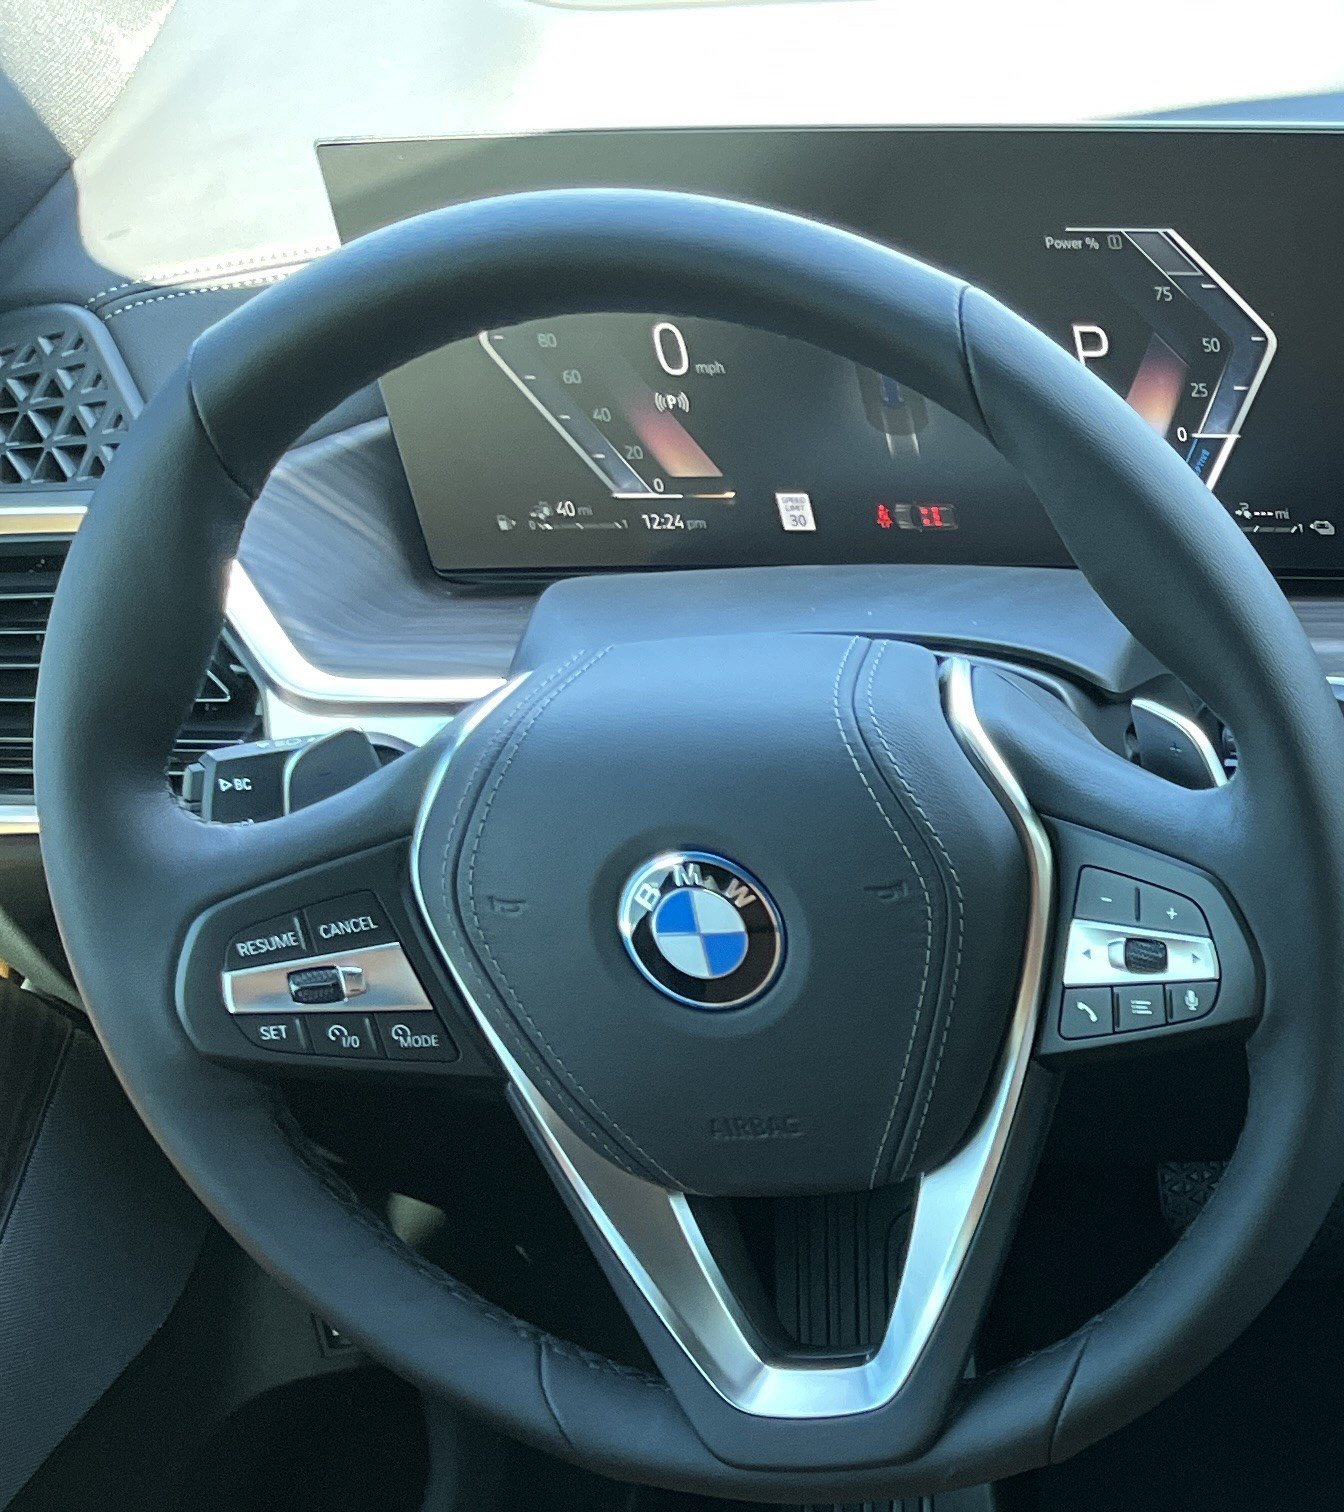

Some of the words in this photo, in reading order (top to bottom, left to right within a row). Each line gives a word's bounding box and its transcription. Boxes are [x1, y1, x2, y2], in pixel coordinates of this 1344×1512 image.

[1045, 236, 1083, 250] Power
[1085, 237, 1100, 250] %
[1154, 286, 1173, 302] 75
[537, 332, 558, 348] 80
[1073, 324, 1109, 366] P
[1202, 338, 1221, 352] 50
[653, 322, 689, 376] 0
[695, 361, 726, 376] mph
[562, 369, 582, 384] 60
[1190, 383, 1208, 397] 25
[592, 407, 612, 422] 40
[1176, 427, 1187, 442] 0
[624, 445, 644, 460] 20
[653, 478, 664, 492] 0
[556, 501, 576, 517] 40
[577, 504, 593, 516] mi
[1274, 508, 1290, 520] mi
[641, 513, 685, 530] 12:24
[686, 519, 707, 531] pm
[790, 514, 807, 527] 30
[233, 778, 252, 791] BC
[634, 862, 757, 912] BMW
[319, 916, 379, 939] CANCEL
[236, 931, 300, 957] RESUME
[260, 1025, 287, 1041] SET
[399, 1034, 440, 1048] MODE
